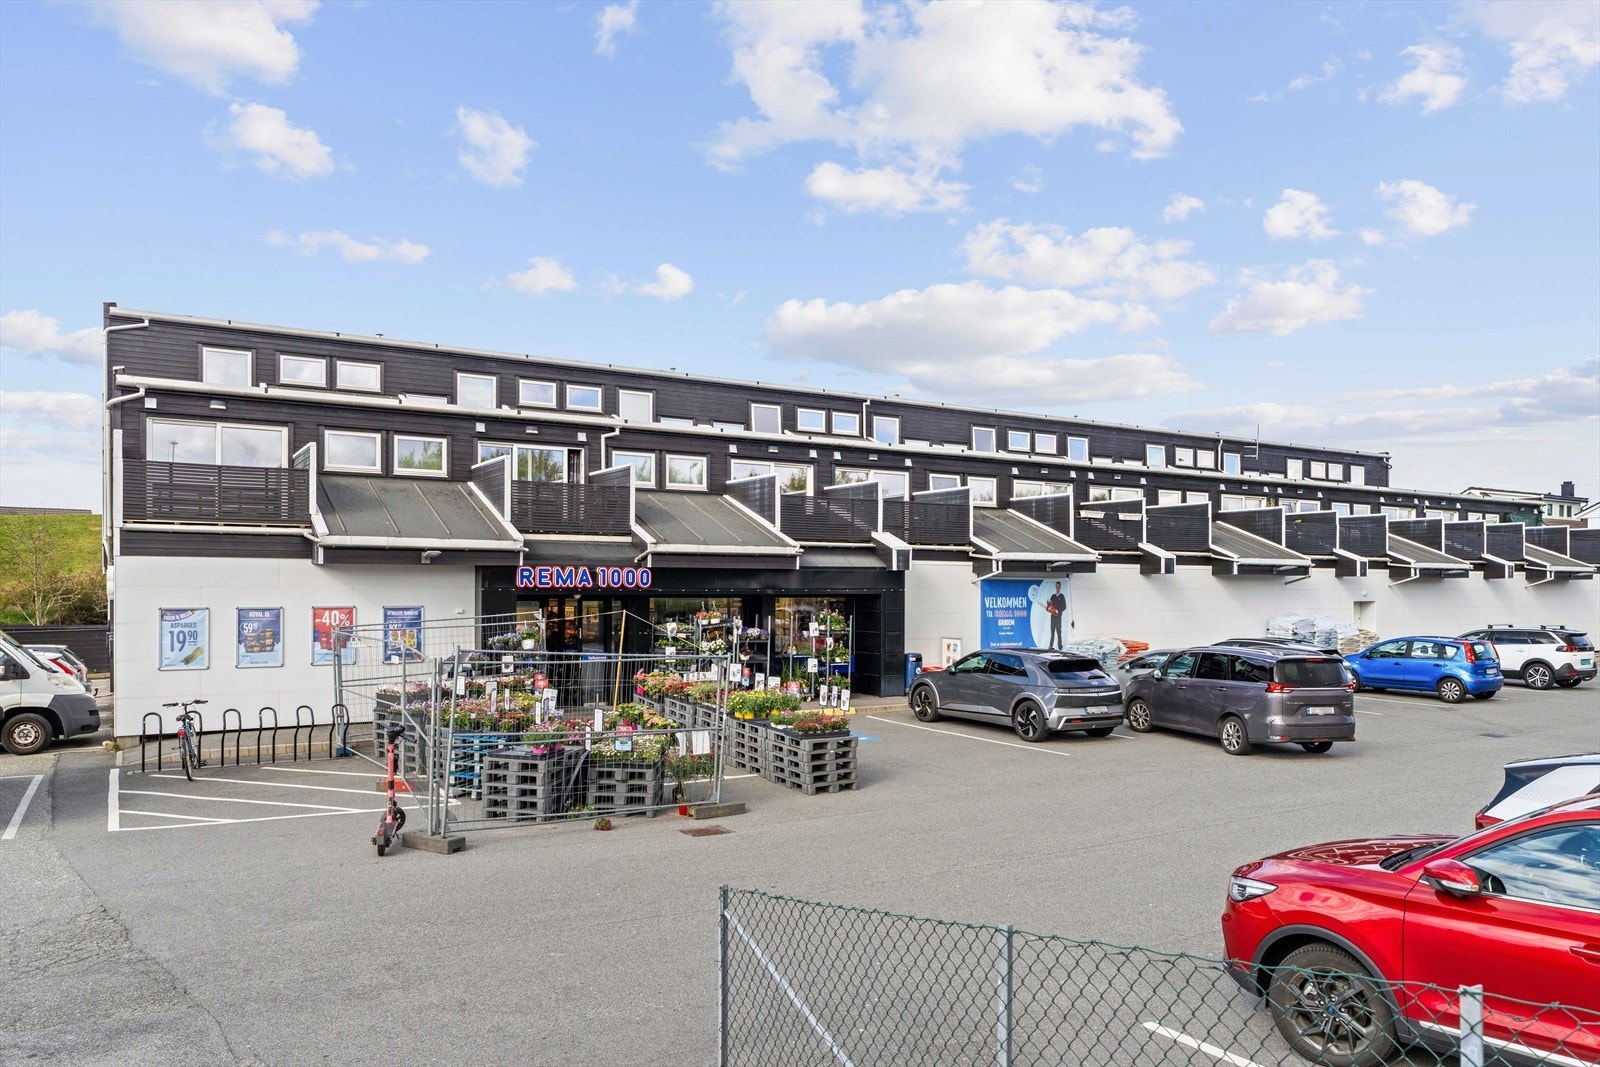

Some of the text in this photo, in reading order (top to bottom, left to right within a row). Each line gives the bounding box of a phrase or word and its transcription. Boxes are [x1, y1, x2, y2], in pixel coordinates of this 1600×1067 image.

[517, 566, 652, 588] REMA 1000
[984, 596, 1027, 608] VELKOMMEN
[315, 610, 351, 627] -40%
